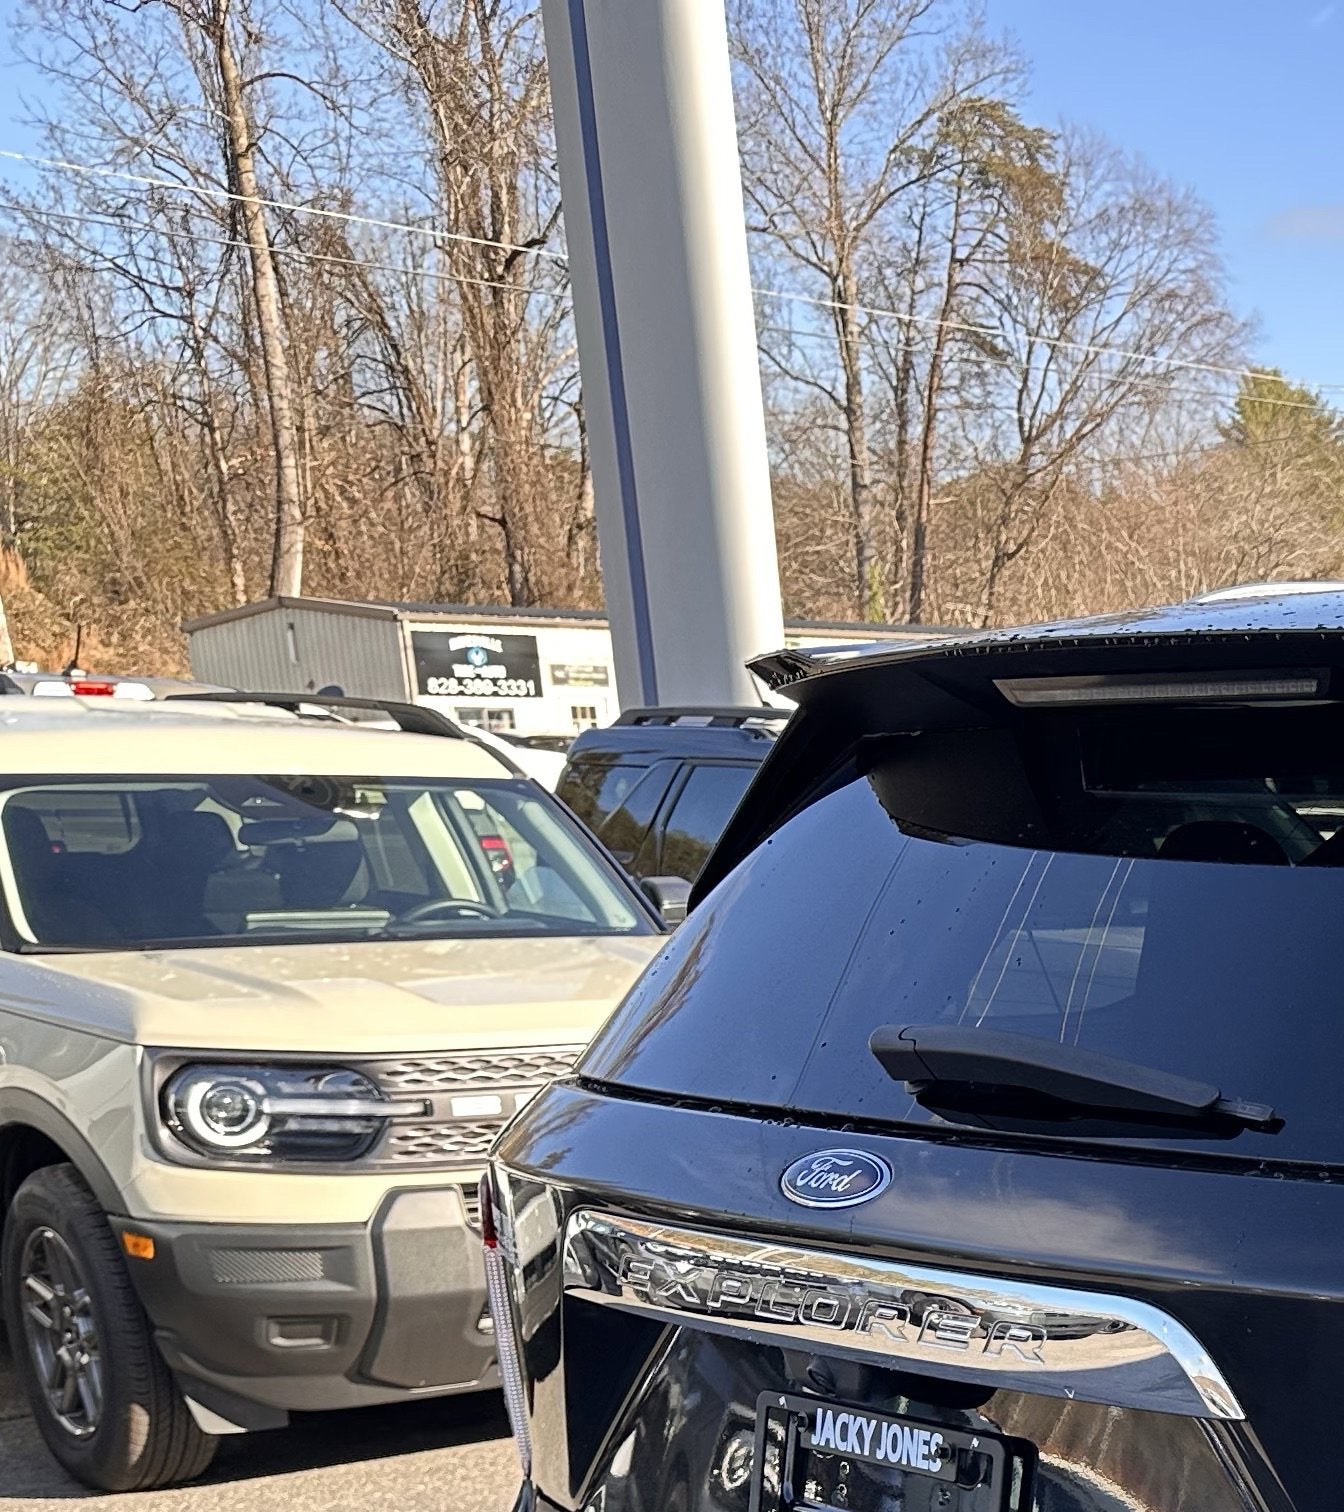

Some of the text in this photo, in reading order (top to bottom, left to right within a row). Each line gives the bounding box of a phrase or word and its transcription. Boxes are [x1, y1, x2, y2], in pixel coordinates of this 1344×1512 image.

[796, 1156, 863, 1192] Ford
[616, 1252, 1049, 1367] EXPLORER
[811, 1407, 944, 1473] JACKY JONES
